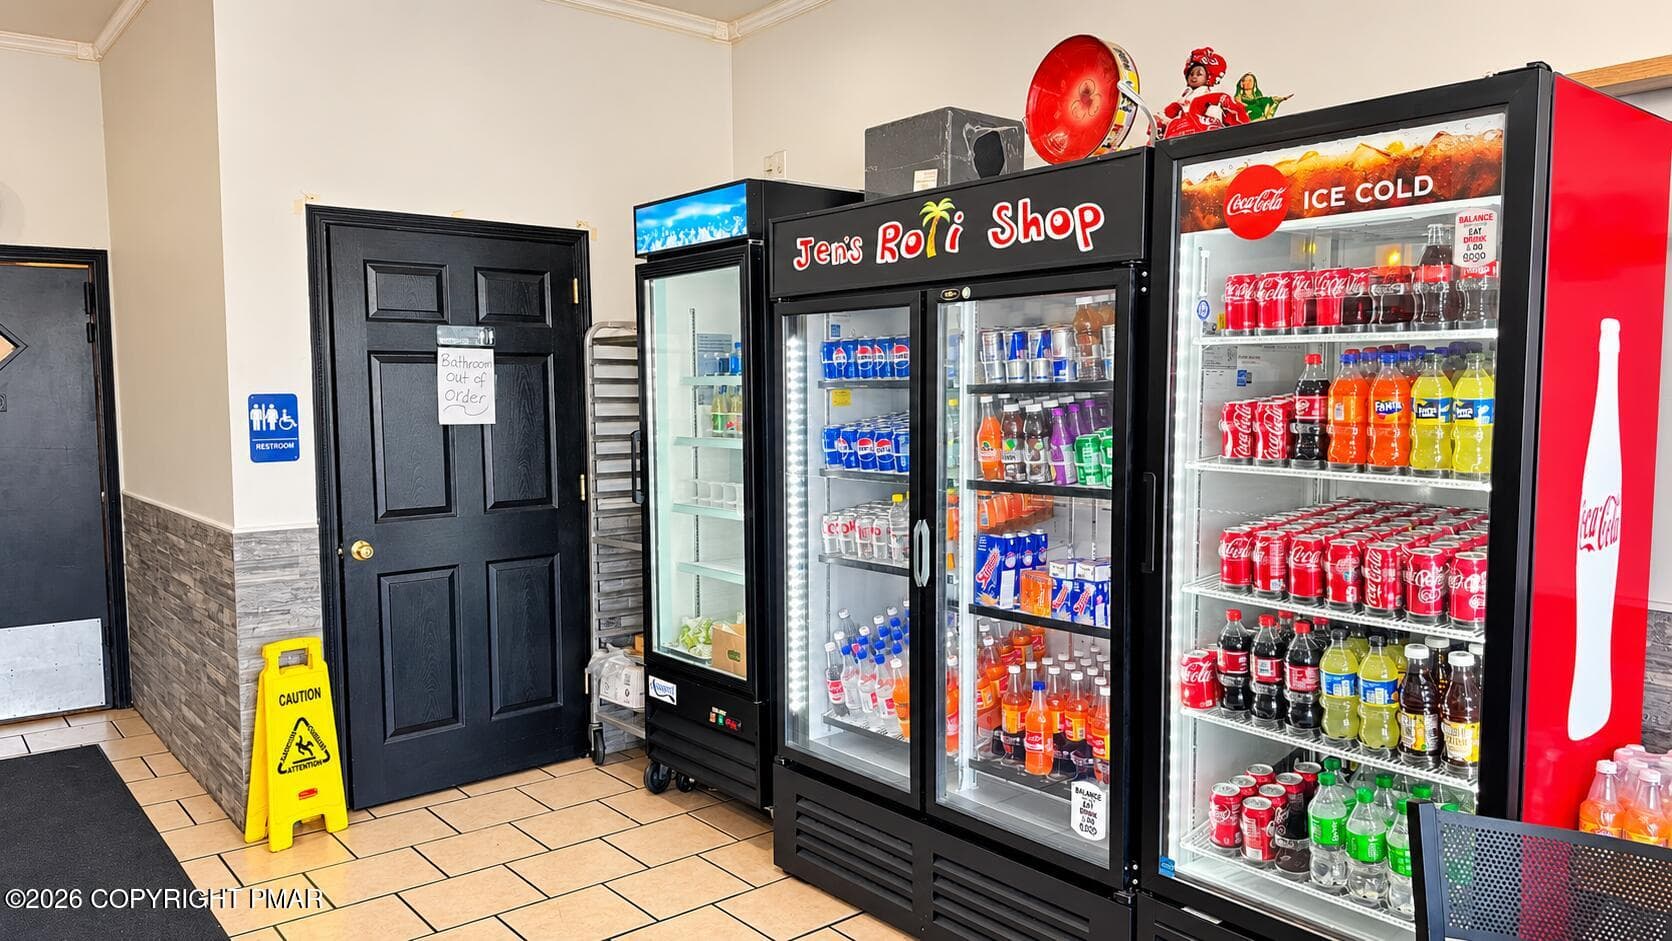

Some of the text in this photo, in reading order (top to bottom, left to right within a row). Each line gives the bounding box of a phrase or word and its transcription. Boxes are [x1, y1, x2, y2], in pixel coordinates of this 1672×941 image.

[1303, 174, 1434, 210] ICE COLD
[1227, 187, 1287, 216] Coca-Cola
[1459, 213, 1494, 224] BALANCE
[793, 235, 863, 272] Jen's
[988, 198, 1105, 252] Shop
[441, 353, 492, 369] Bathroom
[474, 371, 487, 388] of
[445, 388, 487, 404] Order
[255, 442, 295, 450] RESTROOM
[279, 687, 321, 706] CAUTION
[286, 760, 323, 774] ATTENTION
